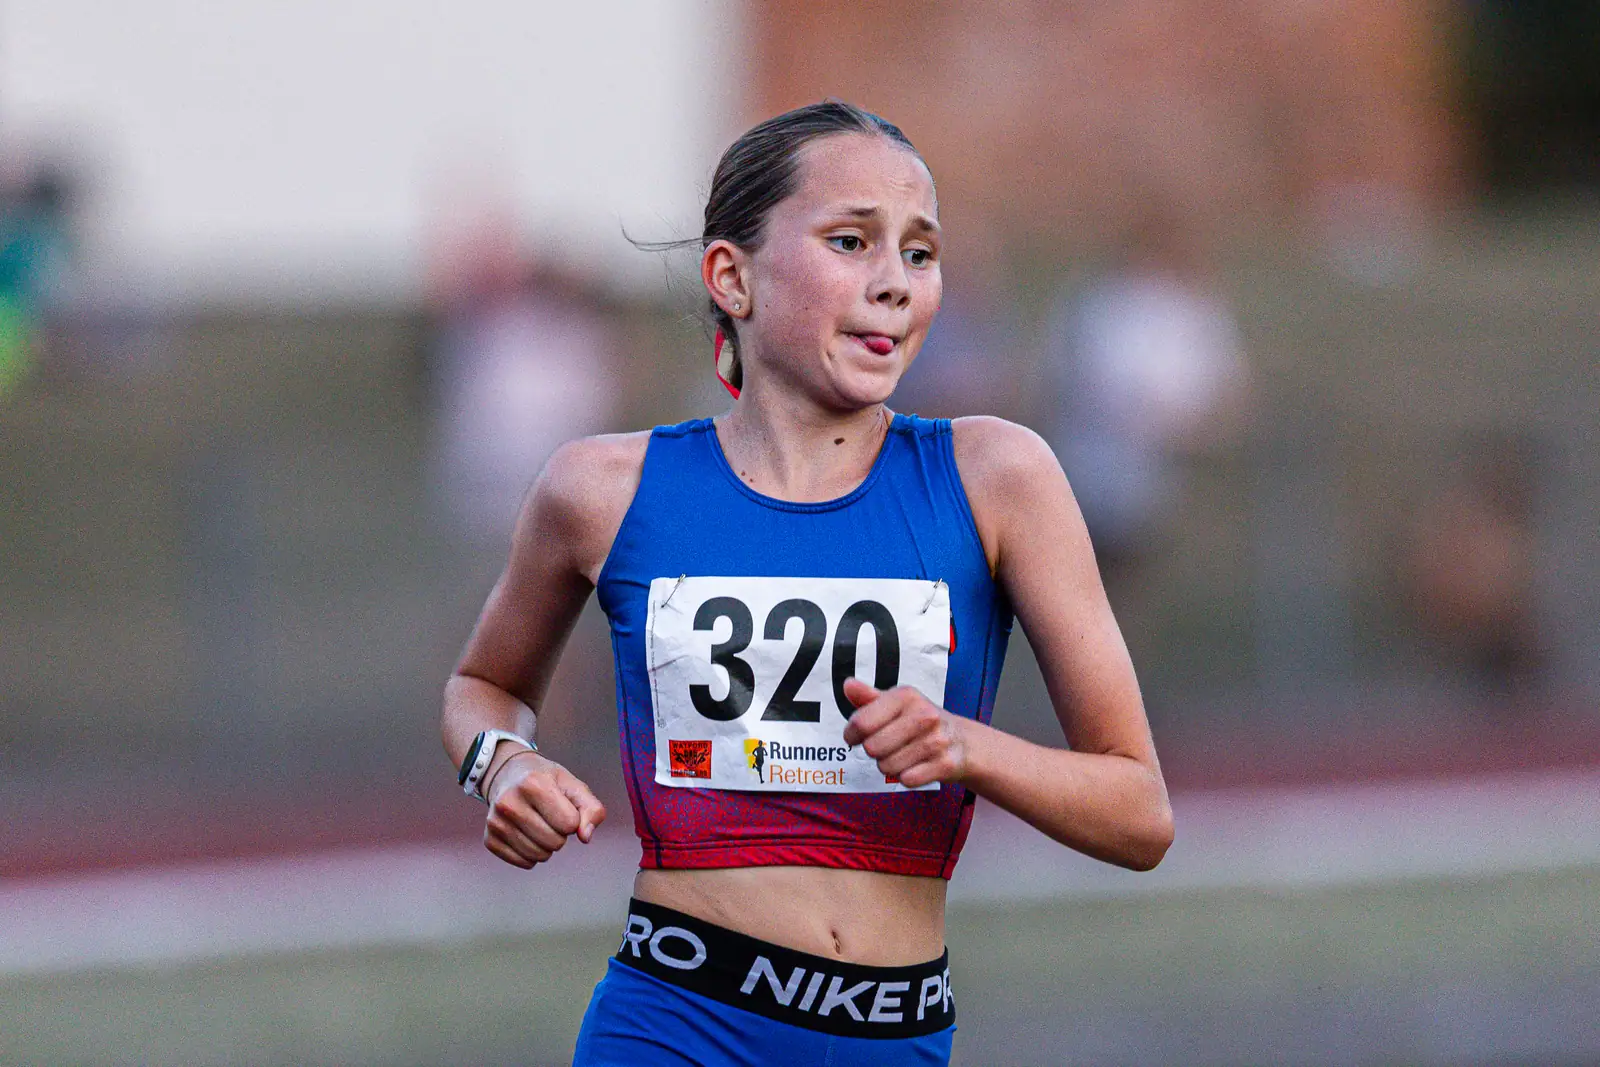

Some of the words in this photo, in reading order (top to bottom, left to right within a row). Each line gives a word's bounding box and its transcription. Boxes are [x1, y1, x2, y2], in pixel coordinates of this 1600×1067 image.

[689, 596, 900, 722] 320
[769, 764, 847, 785] Retreat
[739, 955, 910, 1023] NIKE
